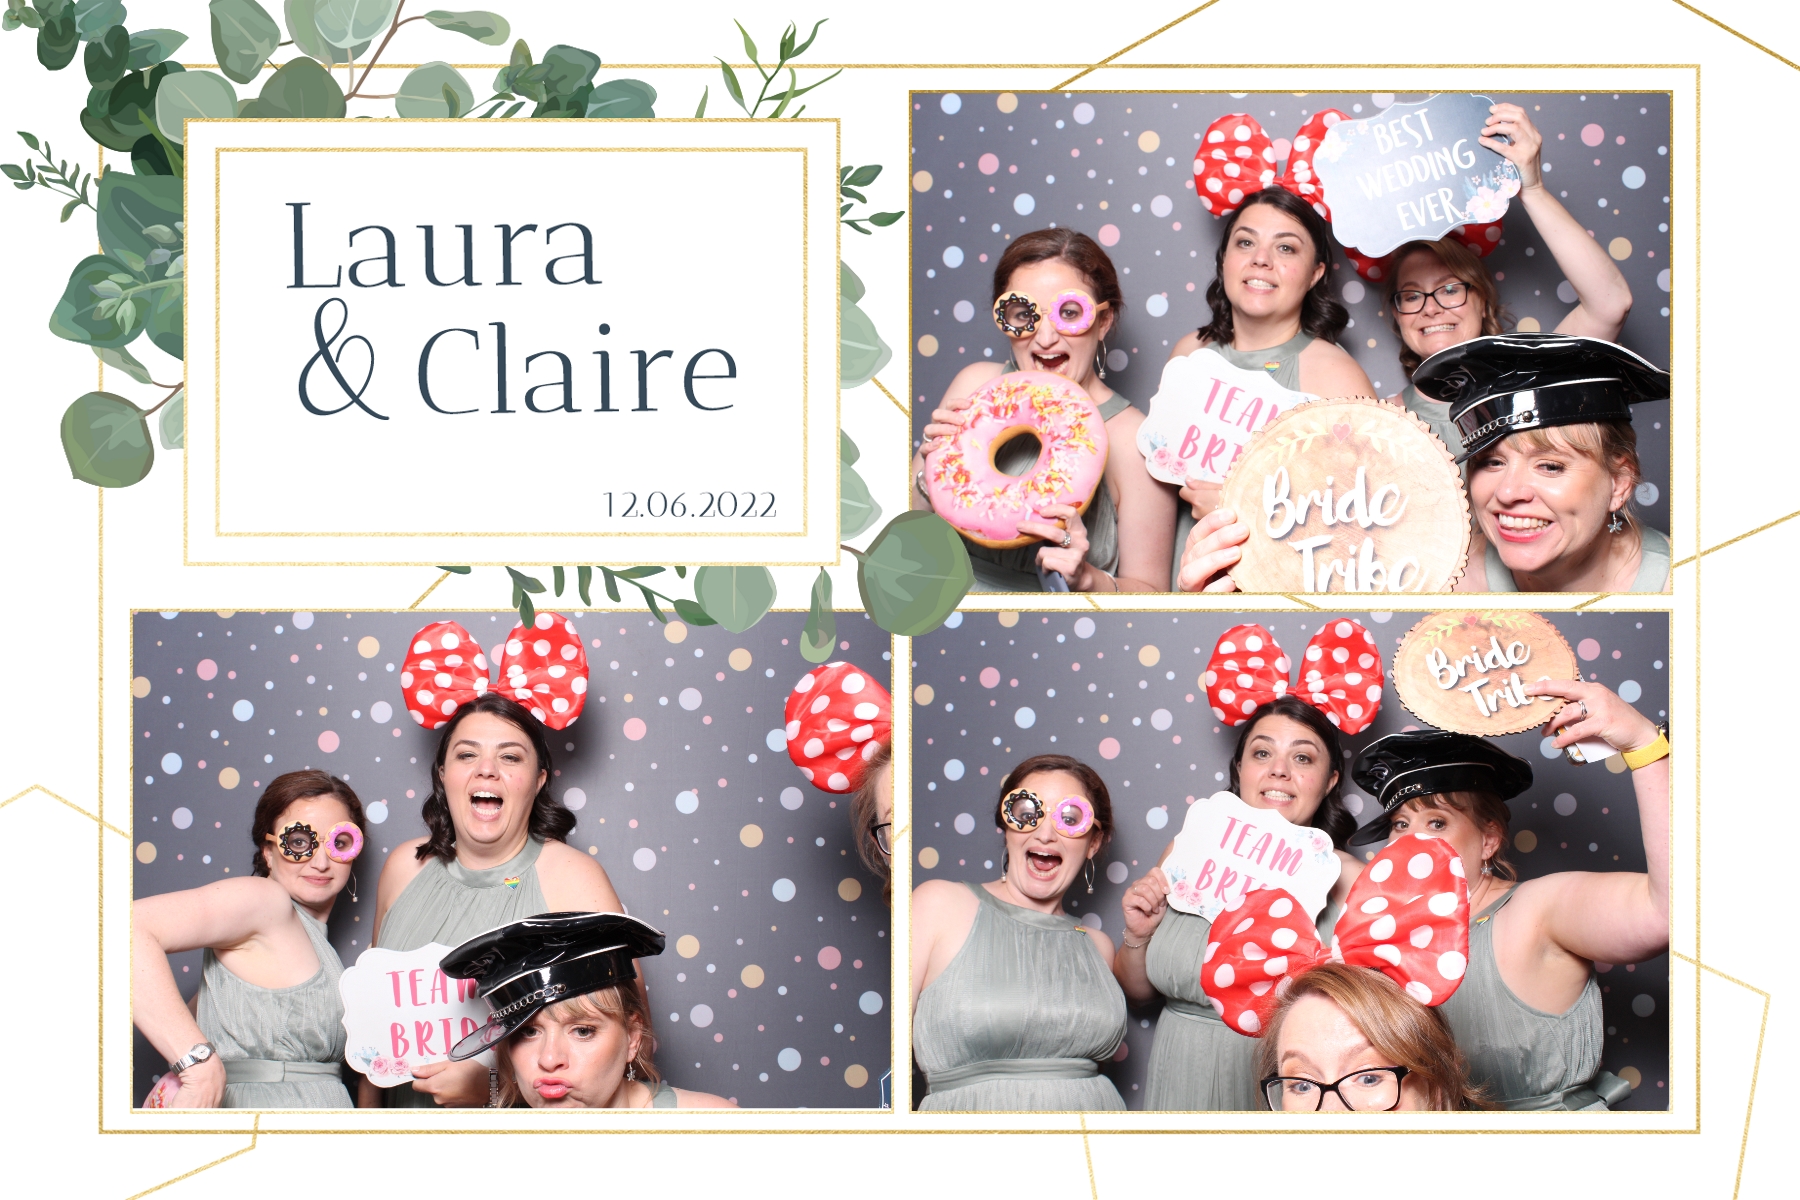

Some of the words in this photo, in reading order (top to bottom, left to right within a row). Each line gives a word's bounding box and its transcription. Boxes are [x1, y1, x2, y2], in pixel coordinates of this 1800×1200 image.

[1372, 108, 1434, 155] BEST
[1356, 138, 1476, 201] WEDDING
[1396, 187, 1465, 231] EVER
[1262, 466, 1409, 539] Bride
[1286, 534, 1430, 593] Tribe
[1425, 636, 1531, 690] Bride
[1219, 815, 1304, 877] TEAM
[1194, 858, 1269, 904] BRI
